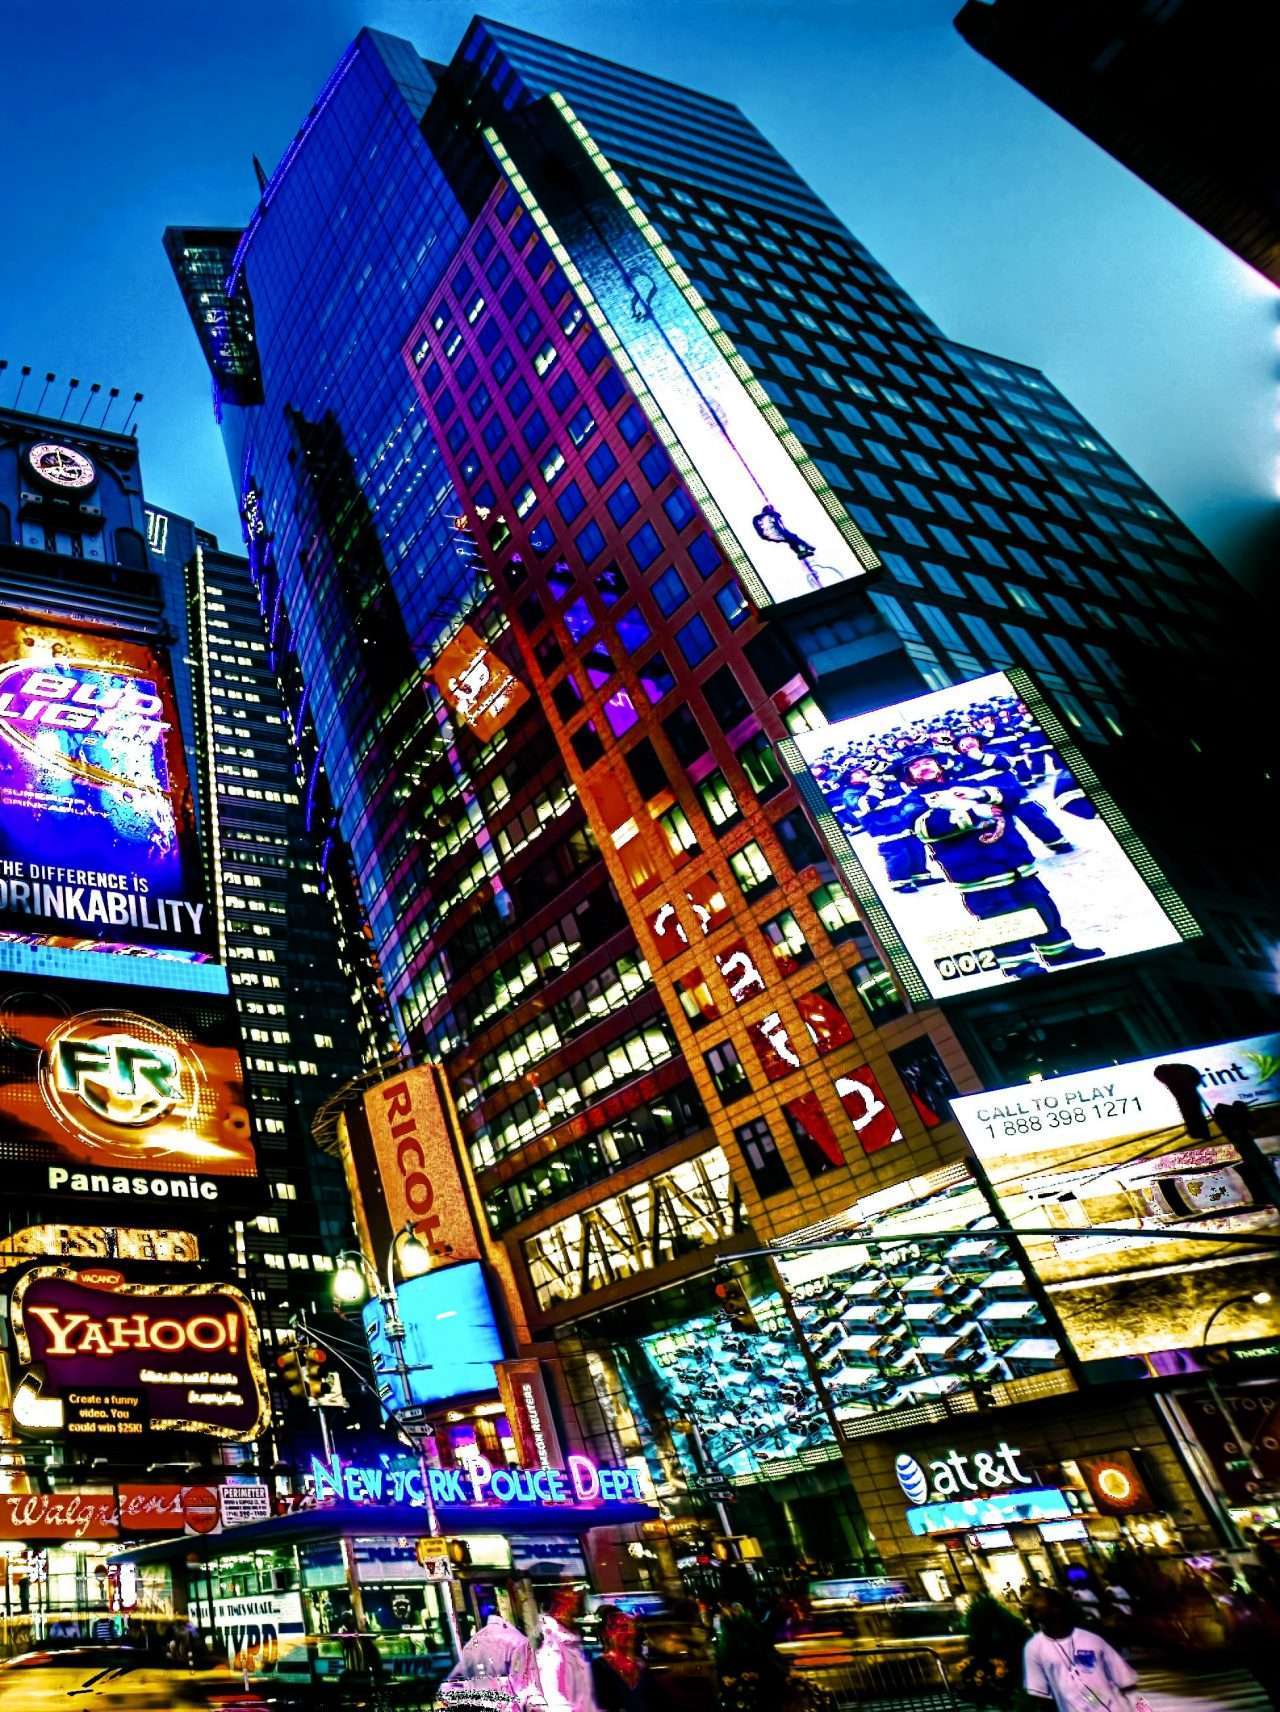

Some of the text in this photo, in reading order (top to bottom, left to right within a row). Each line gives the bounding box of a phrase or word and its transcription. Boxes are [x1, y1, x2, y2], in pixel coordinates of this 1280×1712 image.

[29, 864, 129, 891] DIFFERENCE
[937, 949, 999, 980] 002
[976, 1084, 1116, 1122] CALL TO PLAY
[985, 1096, 1143, 1140] 1 888 398 1271
[48, 1167, 219, 1201] Panasonic
[383, 1080, 446, 1256] RICOH
[81, 1274, 121, 1285] VACANCY
[27, 1306, 240, 1355] YAHOO!
[68, 1393, 139, 1408] Create a funny
[79, 1408, 130, 1419] video. You
[68, 1422, 97, 1433] could
[97, 1422, 116, 1433] win
[310, 1454, 383, 1502] NEW
[469, 1456, 567, 1504] POLICE
[568, 1455, 643, 1502] DEPT
[928, 1442, 1033, 1496] at&t
[223, 1487, 266, 1498] PERIMETER
